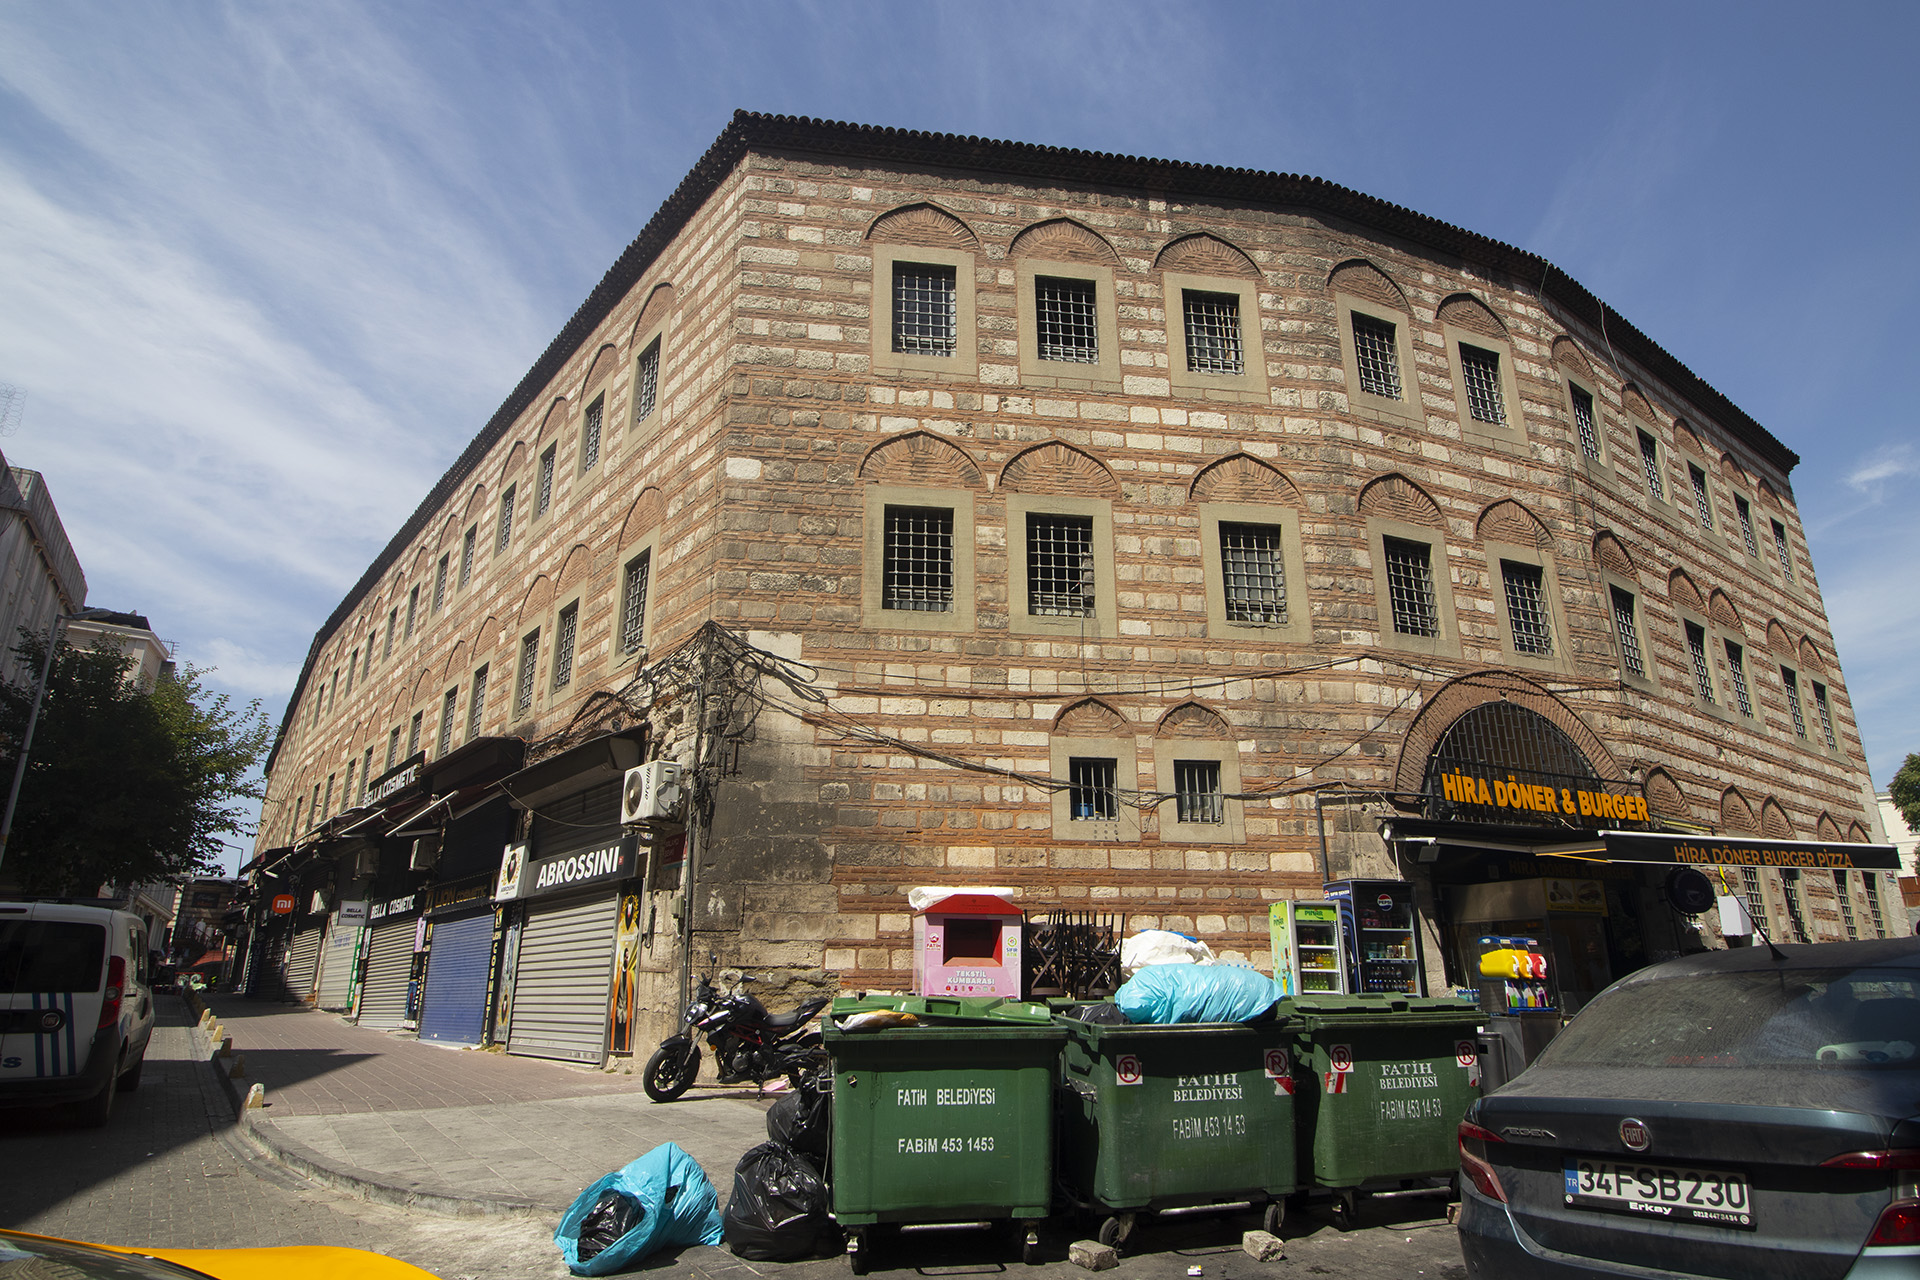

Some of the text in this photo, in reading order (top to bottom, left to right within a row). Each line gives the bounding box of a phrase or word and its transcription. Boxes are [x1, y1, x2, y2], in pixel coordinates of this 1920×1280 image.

[382, 764, 417, 798] COSMETIC
[1441, 767, 1651, 822] HİRA DÖNER & BURGER
[1673, 841, 1855, 868] HİRA DÖNER BURGER PİZZA
[536, 845, 621, 889] ABROSSINI
[370, 894, 416, 920] BELLA COSMETIC
[947, 977, 995, 985] KUMBARASI
[956, 970, 987, 978] TEKSTİL
[1381, 1060, 1433, 1076] FATİH
[1177, 1071, 1238, 1087] FATİH
[1379, 1073, 1438, 1090] BELEDİYESİ
[1173, 1084, 1243, 1102] BELEDİYESİ
[1407, 1099, 1420, 1118] 453
[1422, 1098, 1431, 1117] 14
[1432, 1097, 1441, 1117] 53
[1204, 1116, 1220, 1137] 453
[1222, 1115, 1232, 1135] 14
[1235, 1114, 1245, 1134] 53
[1624, 1127, 1642, 1143] FIAT
[941, 1137, 963, 1152] 453
[967, 1137, 995, 1152] 1453
[1567, 1177, 1578, 1187] TR
[1629, 1201, 1673, 1215] Erkay
